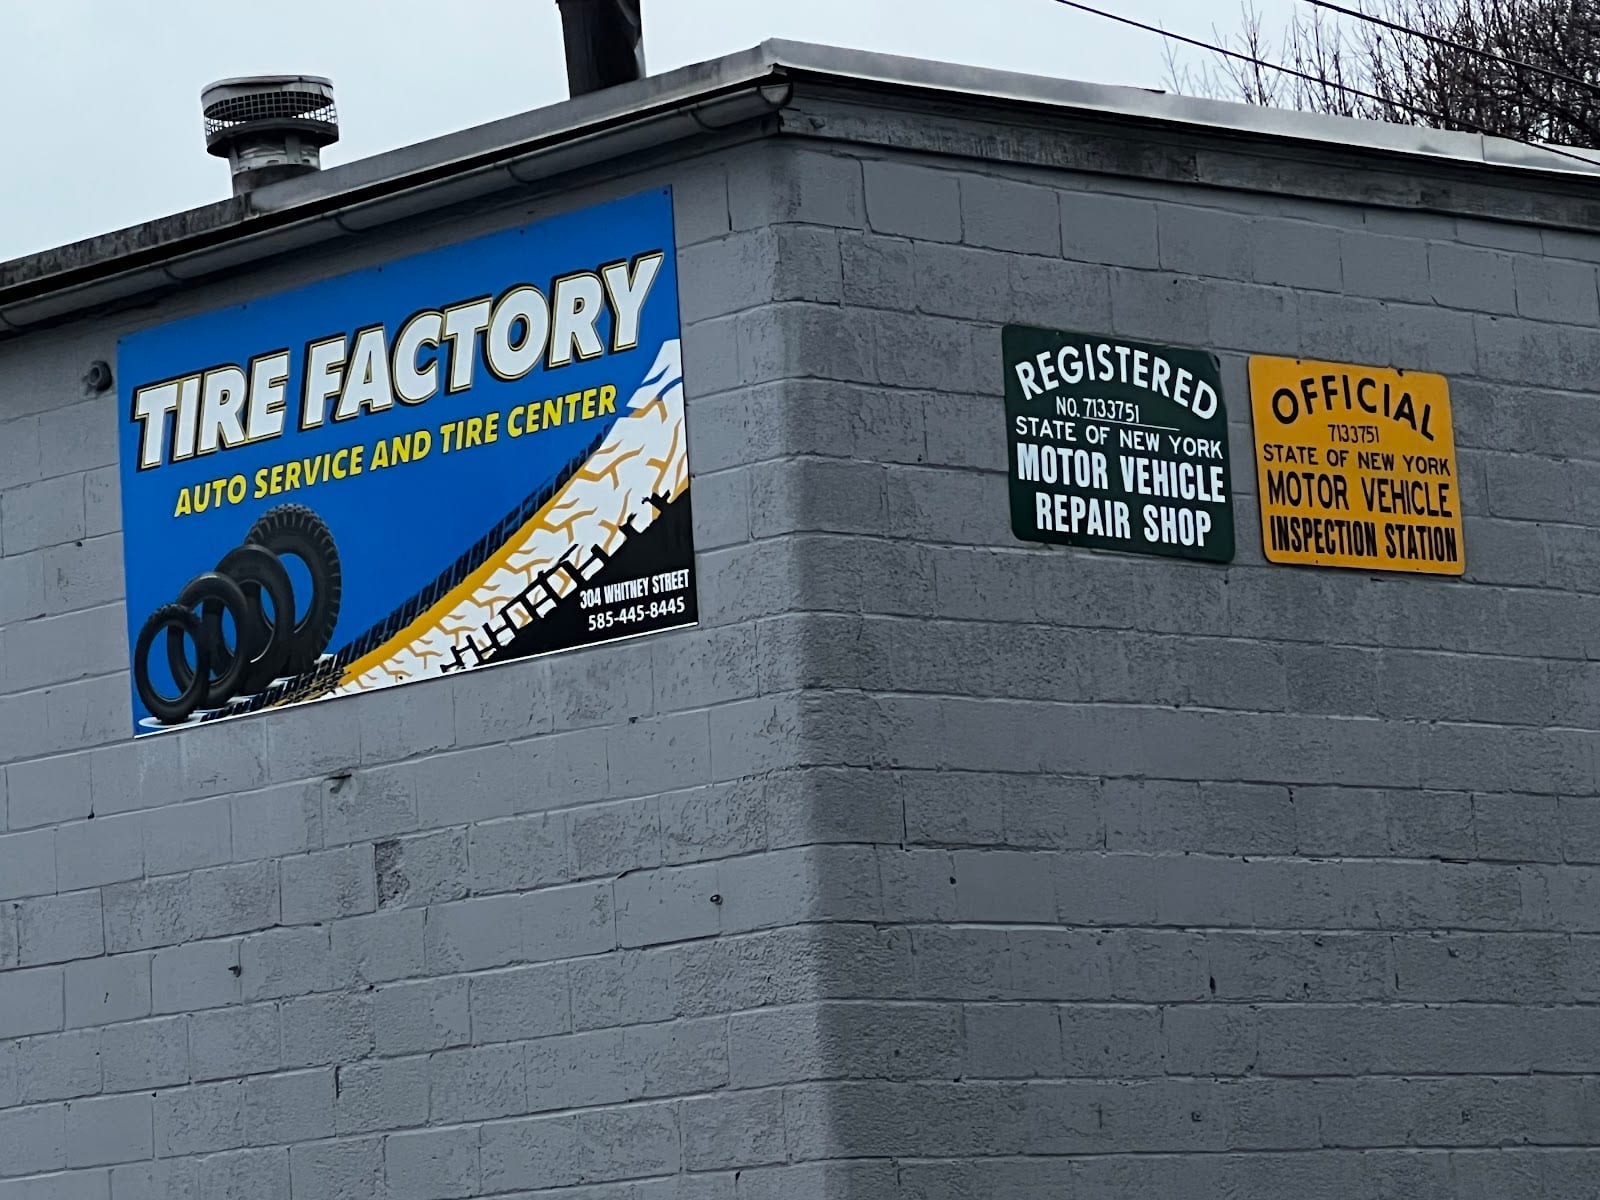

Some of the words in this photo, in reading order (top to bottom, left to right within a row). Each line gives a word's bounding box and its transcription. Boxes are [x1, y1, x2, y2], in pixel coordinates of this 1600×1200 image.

[133, 349, 290, 471] TIRE
[301, 251, 665, 431] FACTORY
[1015, 344, 1218, 420] REGISTERED
[1056, 396, 1080, 417] NO.
[1083, 398, 1140, 423] 7133751
[1272, 374, 1434, 441] OFFICIAL
[174, 474, 246, 518] AUTO
[254, 446, 363, 500] SERVICE
[369, 430, 431, 472] AND
[440, 410, 499, 452] TIRE
[506, 385, 617, 437] CENTER
[1015, 415, 1076, 441] STATE
[1086, 425, 1110, 445] OF
[1120, 429, 1160, 452] NEW
[1168, 435, 1223, 459] YORK
[1327, 424, 1379, 443] 7133751
[1017, 442, 1108, 490] MOTOR
[1119, 455, 1226, 503] VEHICLE
[1263, 444, 1318, 465] STATE
[1326, 449, 1349, 467] OF
[1358, 452, 1394, 471] NEW
[1402, 455, 1451, 476] YORK
[1267, 470, 1349, 510] MOTOR
[1361, 477, 1452, 517] VEHICLE
[1035, 492, 1131, 539] REPAIR
[1143, 504, 1211, 547] SHOP
[1270, 515, 1378, 557] INSPECTION
[1384, 523, 1457, 562] STATION
[580, 587, 601, 609] 304
[604, 577, 649, 604] WHITNEY
[652, 569, 689, 594] STREET
[588, 596, 685, 631] 585-445-8445
